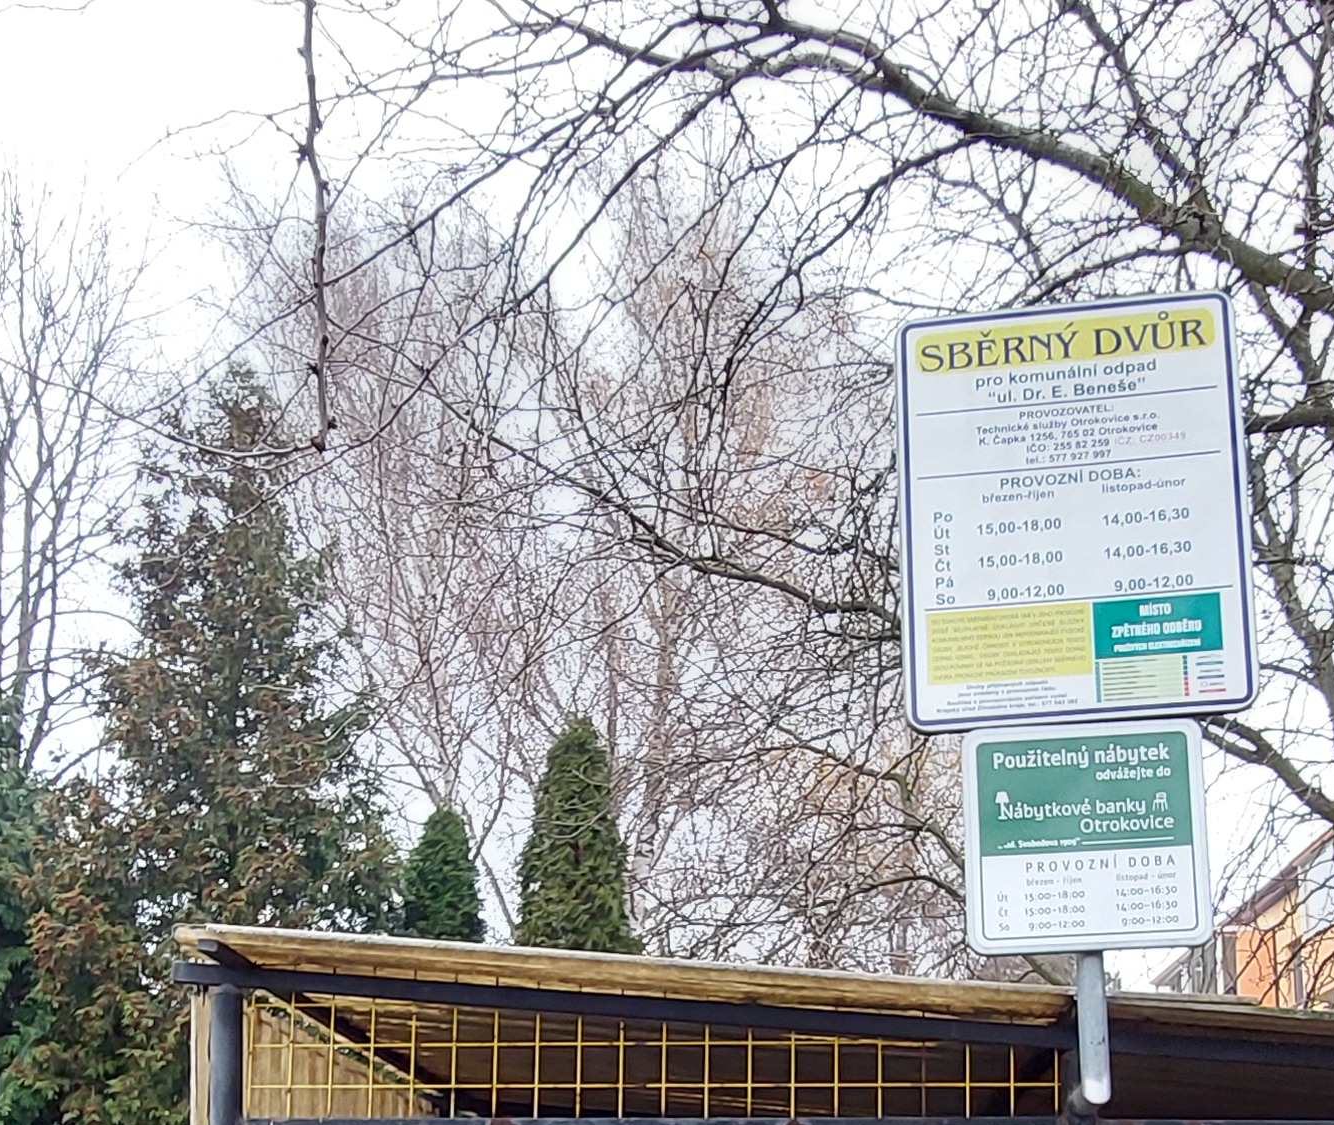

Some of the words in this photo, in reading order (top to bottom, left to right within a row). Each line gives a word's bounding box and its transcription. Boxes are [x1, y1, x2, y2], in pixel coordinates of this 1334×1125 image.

[920, 322, 1079, 373] SBĚRNÝ
[1094, 310, 1207, 357] DVŮR
[975, 374, 1003, 390] pro
[1009, 363, 1098, 386] komunální
[1103, 359, 1157, 378] odpad
[1023, 386, 1046, 400] Dr.
[1052, 385, 1067, 398] E.
[1019, 404, 1114, 420] PROVOZOVATEL:
[976, 422, 1029, 436] Technické
[1033, 419, 1067, 432] služby
[1071, 415, 1130, 428] Otrokovice
[1133, 411, 1160, 422] s.r.o.
[979, 437, 989, 446] K.
[993, 432, 1026, 446] Čapka
[1061, 429, 1079, 439] 765
[1082, 427, 1095, 437] 02
[1098, 422, 1158, 436] Otrokovice
[1053, 441, 1072, 452] 255
[1075, 440, 1088, 450] 82
[1091, 438, 1110, 448] 259
[1049, 453, 1067, 463] 577
[1071, 451, 1089, 461] 927
[1093, 449, 1111, 459] 997
[999, 470, 1083, 490] PROVOZNÍ
[1089, 467, 1141, 483] DOBA:
[982, 488, 1055, 504] březen-říjen
[1101, 477, 1186, 494] listopad-únor
[933, 512, 953, 524] Po
[976, 517, 1062, 537] 15,00-18,00
[1102, 507, 1190, 528] 14,00-16,30
[934, 526, 950, 540] Út
[934, 544, 950, 556] St
[978, 550, 1063, 570] 15,00-18,00
[1104, 540, 1192, 561] 14,00-16,30
[935, 558, 951, 573] Čt
[935, 575, 954, 589] Pá
[936, 593, 955, 606] So
[987, 583, 1065, 602] 9,00-12,00
[1114, 573, 1194, 594] 9,00-12,00
[1139, 602, 1172, 617] MÍSTO
[1111, 621, 1160, 638] ZPĚTNÉHO
[1162, 618, 1202, 634] ODBĚRU
[993, 745, 1089, 770] Použitelný
[1094, 742, 1170, 766] nábytek
[1095, 767, 1153, 781] odvážejte
[1156, 765, 1171, 777] do
[998, 798, 1092, 820] Nábytkové
[1095, 797, 1146, 815] banky
[1080, 815, 1175, 833] Otrokovice
[1025, 854, 1118, 873] PROVOZNÍ
[1128, 854, 1176, 868] DOBA
[1026, 876, 1054, 887] březen
[1116, 872, 1148, 883] listopad
[997, 891, 1008, 902] Út
[1024, 890, 1085, 902] 15:00-18:00
[1115, 886, 1178, 898] 14:00-16:30
[998, 906, 1008, 917] Čt
[1024, 905, 1086, 917] 15:00-18:00
[1116, 900, 1178, 913] 14:00-16:30
[998, 923, 1010, 932] So
[1028, 919, 1085, 932] 9:00-12:00
[1121, 915, 1179, 927] 9:00-12:00
